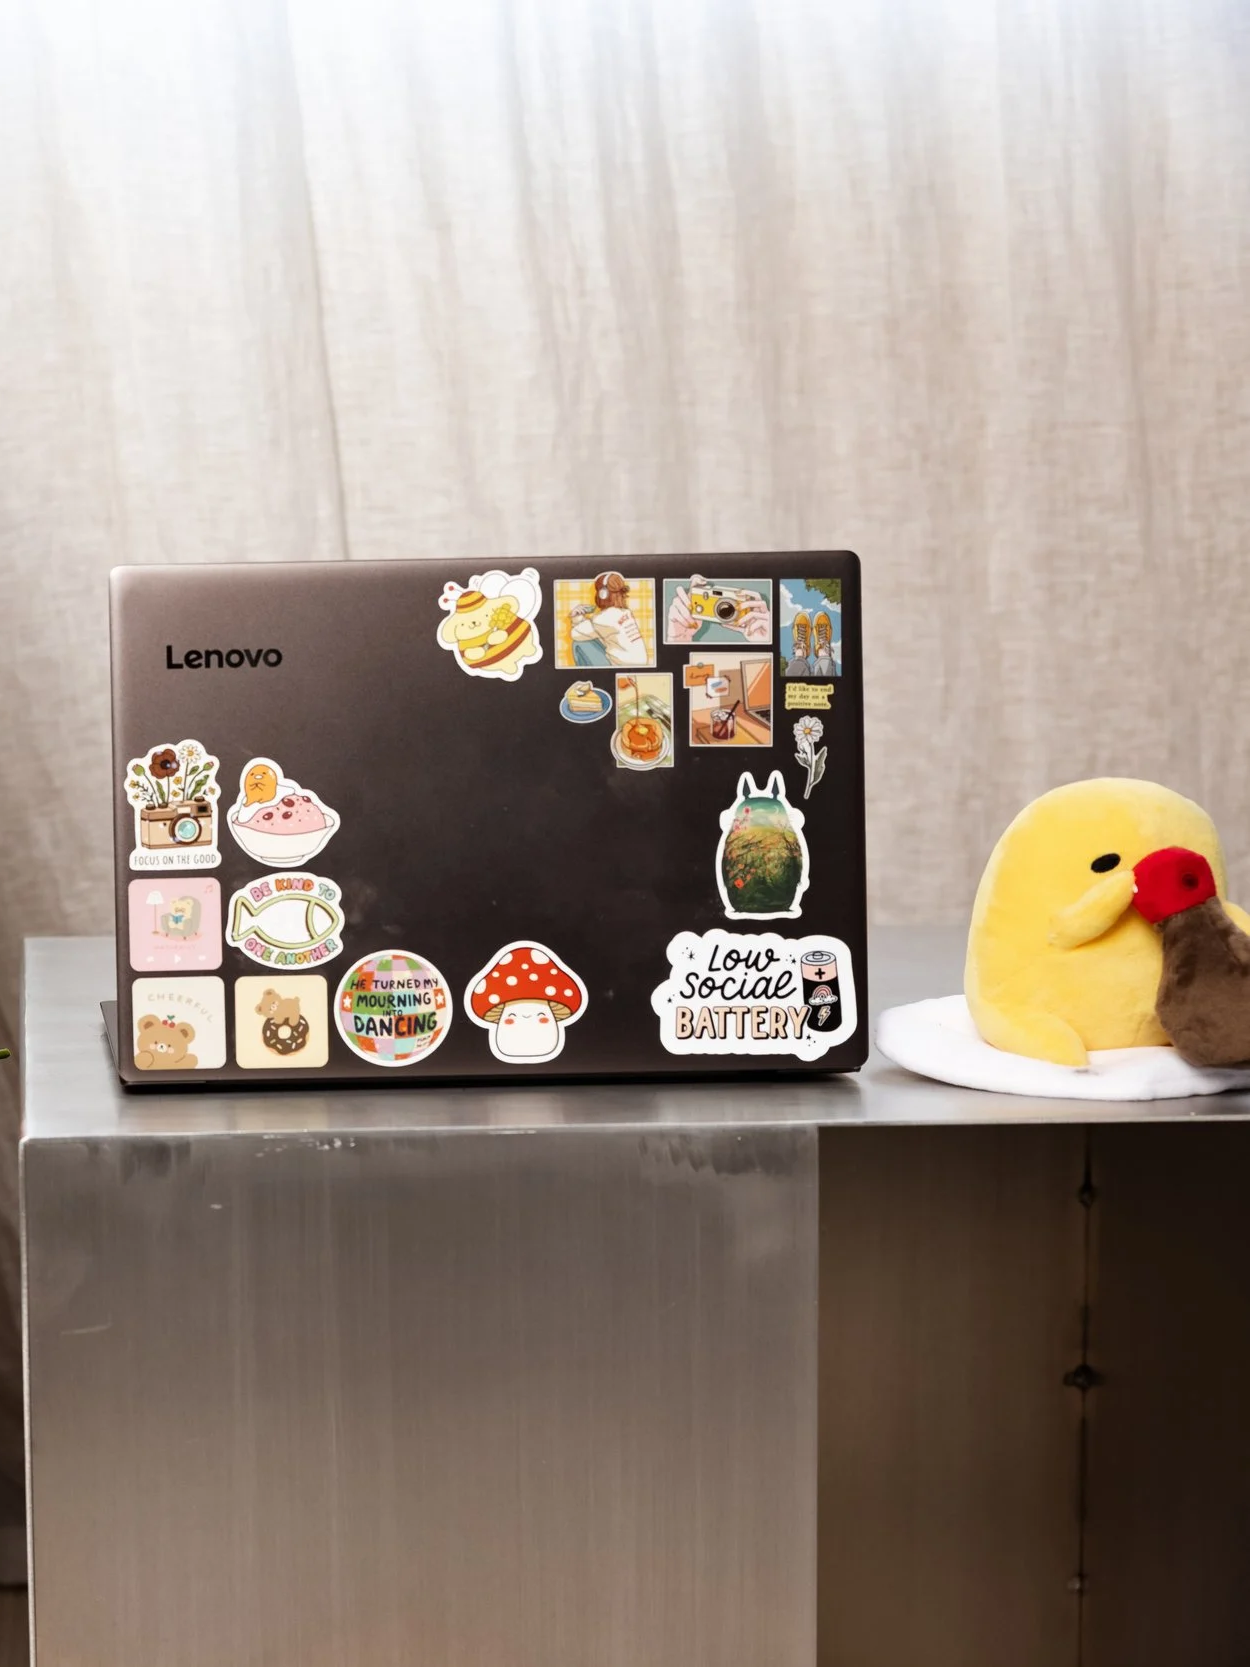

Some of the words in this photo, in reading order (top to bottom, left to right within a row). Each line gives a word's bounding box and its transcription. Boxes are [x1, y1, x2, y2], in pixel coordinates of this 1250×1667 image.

[166, 645, 283, 669] Lenovo
[134, 855, 160, 866] FOCUS
[162, 855, 174, 865] ON
[177, 854, 190, 865] THE
[193, 853, 217, 864] GOOD
[250, 881, 273, 902] BE
[275, 878, 314, 892] KIND
[318, 883, 336, 901] TO
[245, 938, 274, 962] ONE
[274, 939, 338, 966] ANOTHER
[708, 944, 781, 972] Low
[350, 979, 367, 990] HE
[373, 979, 421, 990] TURNED
[423, 977, 439, 988] MY
[147, 993, 214, 1023] CHEERFUL
[356, 992, 432, 1008] MOURNING
[353, 1011, 438, 1037] DANCING
[382, 1009, 403, 1017] INTO
[675, 1004, 810, 1040] BATTERY
